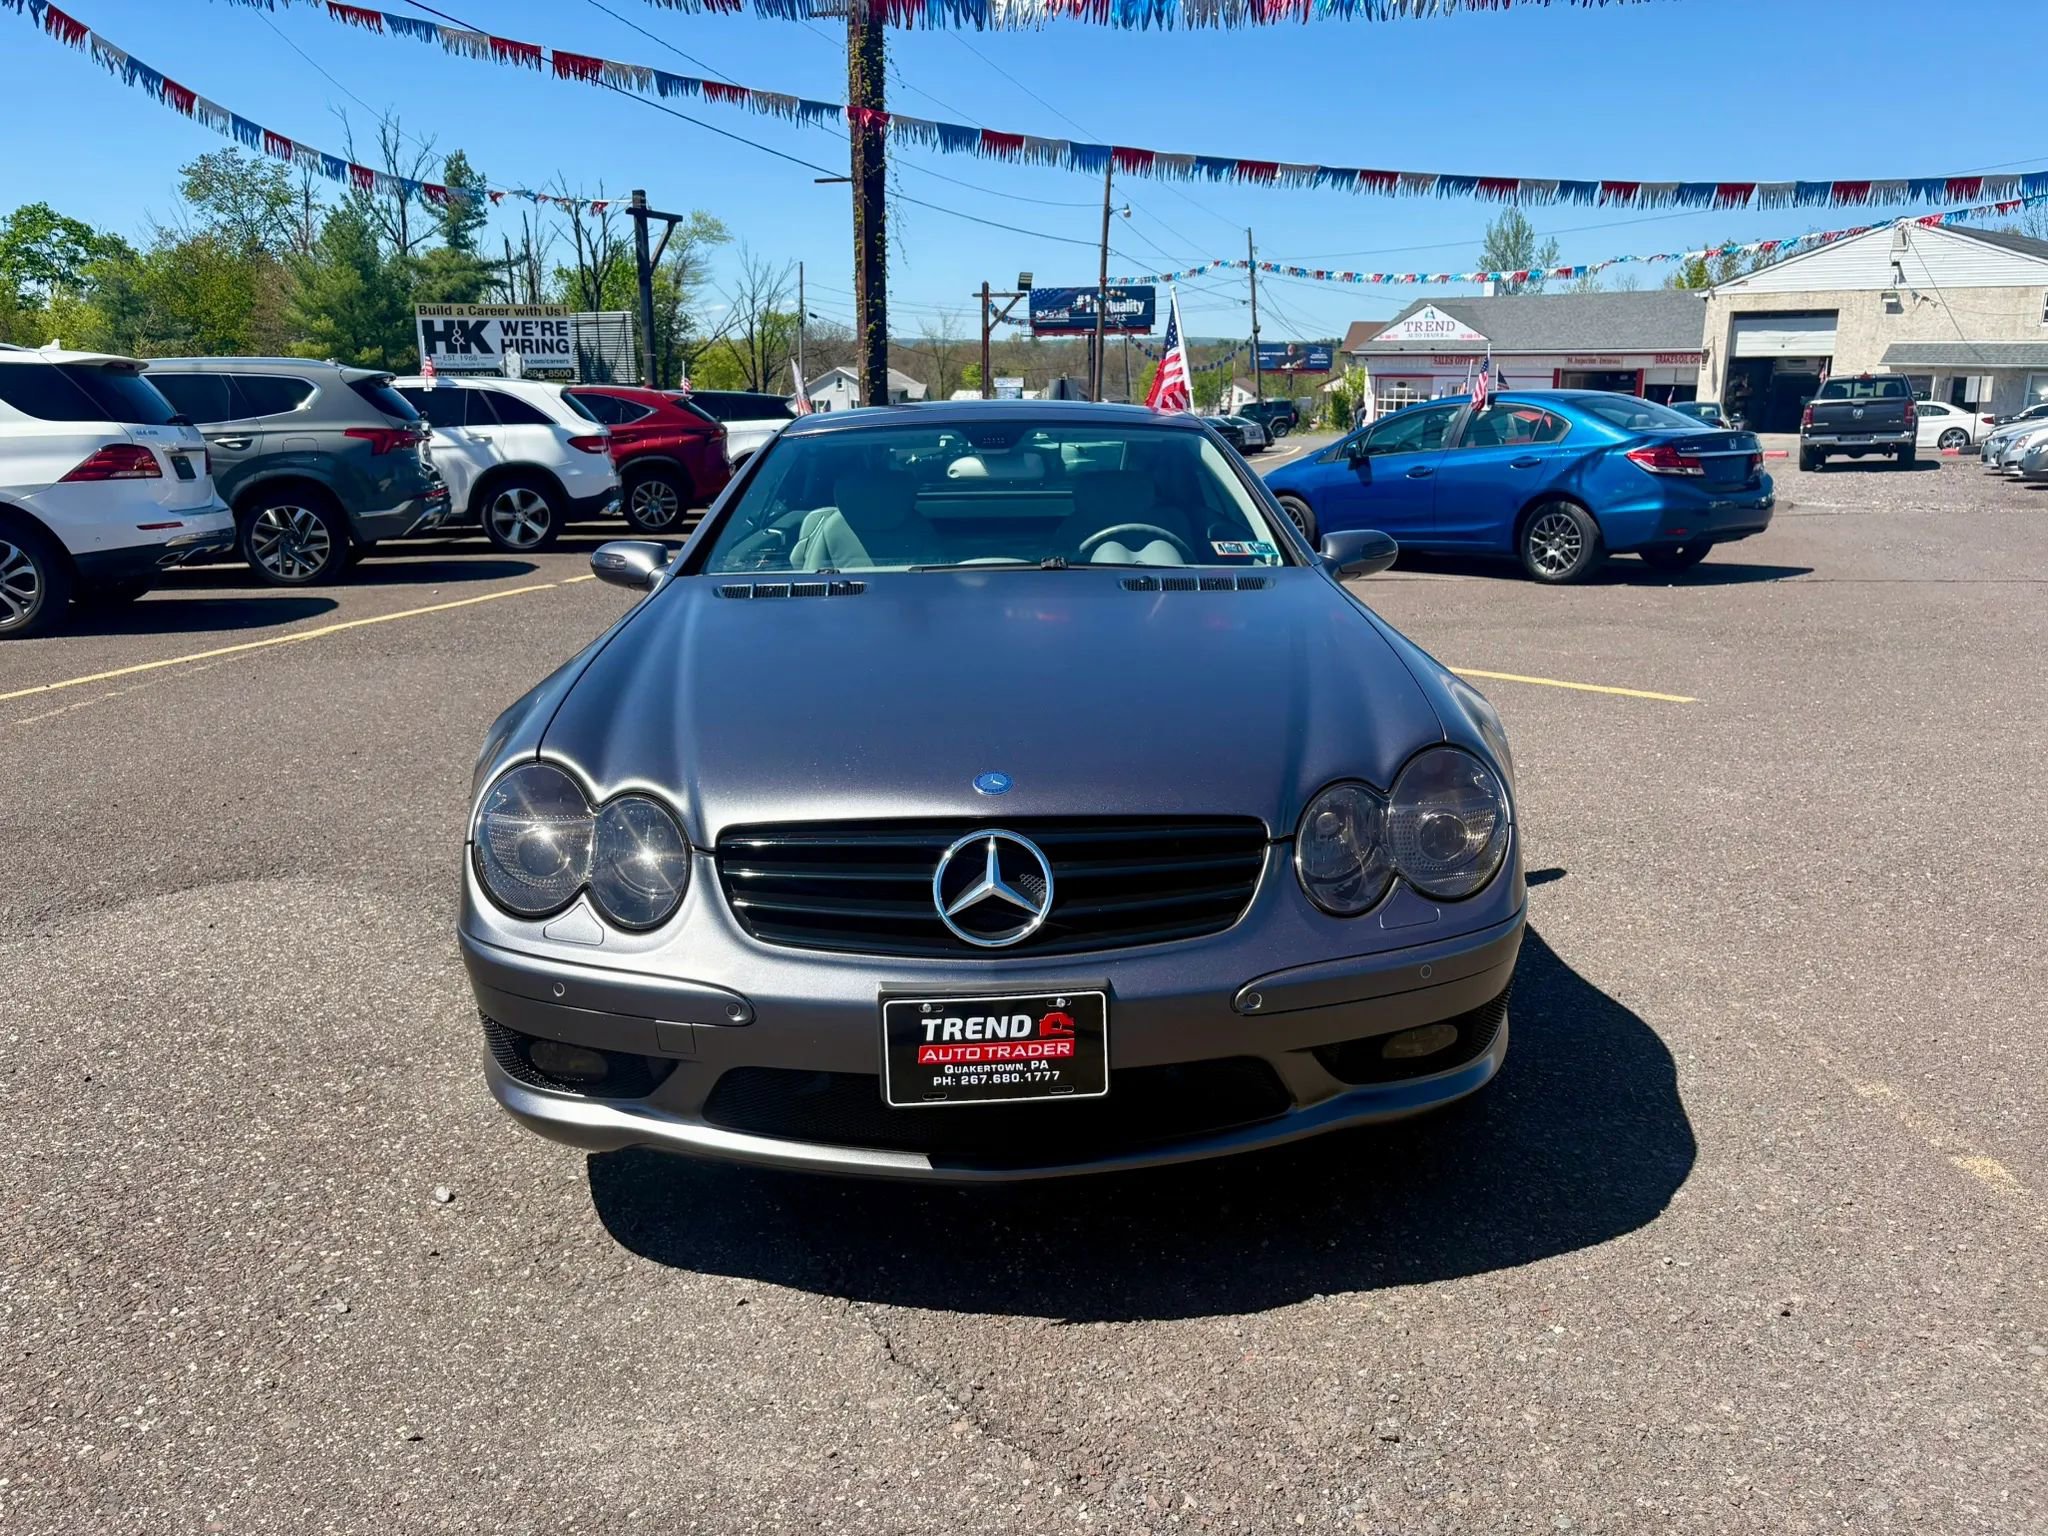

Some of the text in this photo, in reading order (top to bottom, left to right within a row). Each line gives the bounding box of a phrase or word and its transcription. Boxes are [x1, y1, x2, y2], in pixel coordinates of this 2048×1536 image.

[419, 305, 452, 316] Build
[456, 308, 465, 316] a
[468, 305, 510, 316] Career
[514, 306, 542, 316] with
[500, 320, 569, 336] WE'RE
[1404, 321, 1455, 332] TREND
[501, 339, 570, 355] HIRING
[921, 1014, 1032, 1041] TREND
[922, 1042, 1071, 1062] AUTO TRADER
[1030, 1060, 1049, 1071] PA
[933, 1070, 1061, 1087] PH: 267.680.1777
